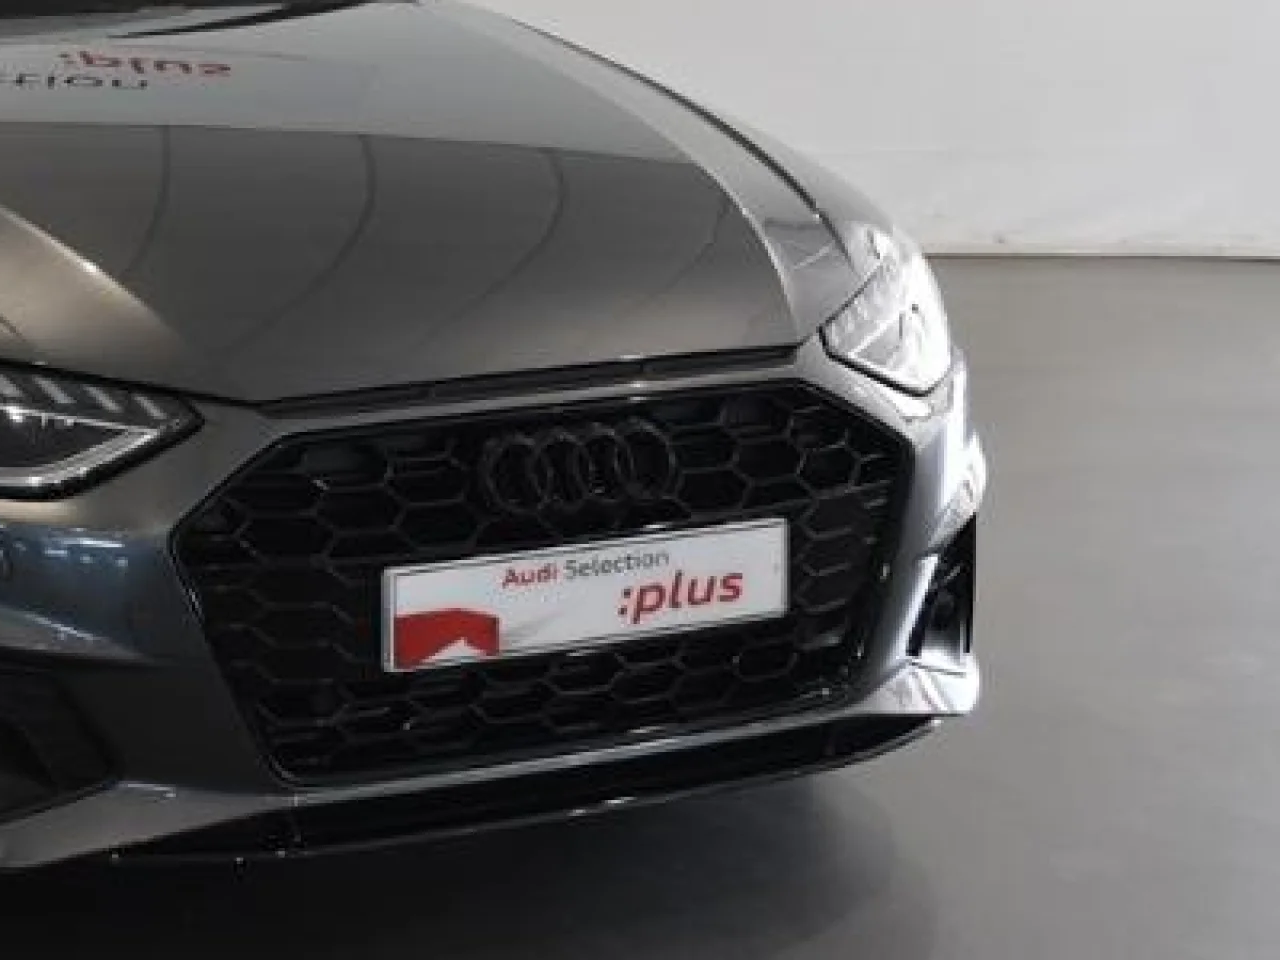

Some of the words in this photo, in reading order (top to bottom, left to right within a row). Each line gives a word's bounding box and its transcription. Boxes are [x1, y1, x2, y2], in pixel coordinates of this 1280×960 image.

[502, 562, 559, 589] Audi
[565, 550, 670, 580] Selection
[617, 569, 744, 624] :plus
